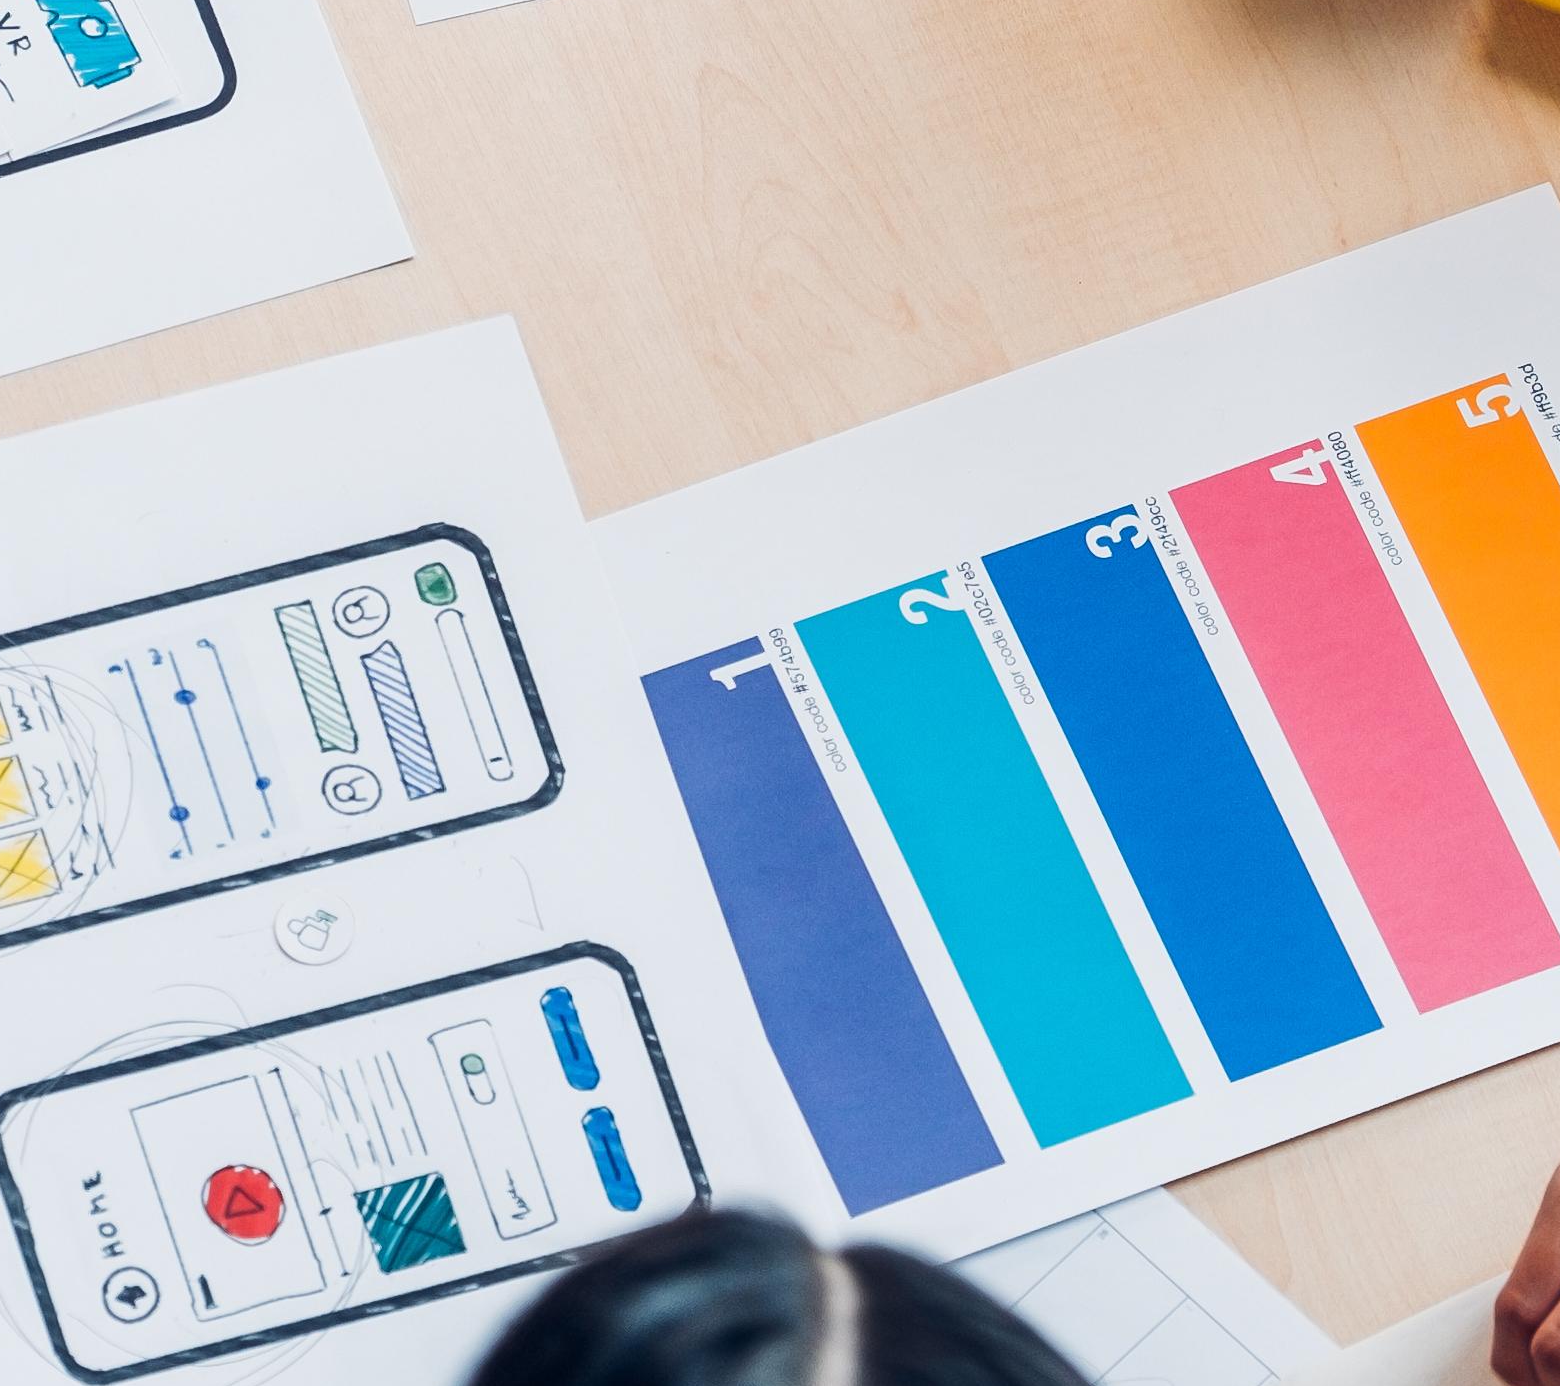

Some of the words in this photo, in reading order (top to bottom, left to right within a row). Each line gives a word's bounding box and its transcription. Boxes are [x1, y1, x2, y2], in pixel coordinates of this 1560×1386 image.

[1460, 383, 1521, 427] 5
[1518, 363, 1556, 419] #ff9b3d
[1269, 447, 1329, 486] 4
[1327, 431, 1363, 486] #ff4080
[1145, 496, 1180, 555] #2f49cc
[1359, 491, 1383, 526] code
[1085, 515, 1149, 559] 3
[1377, 532, 1402, 565] color
[956, 561, 996, 625] #02c7e5
[1176, 560, 1199, 596] code
[899, 574, 966, 625] 2
[1194, 602, 1218, 635] color
[768, 628, 808, 693] #574b99
[992, 630, 1015, 665] code
[709, 652, 774, 691] 1
[1010, 671, 1034, 704] color
[804, 696, 828, 732] code
[822, 738, 846, 771] color
[81, 1171, 120, 1257] HOME
